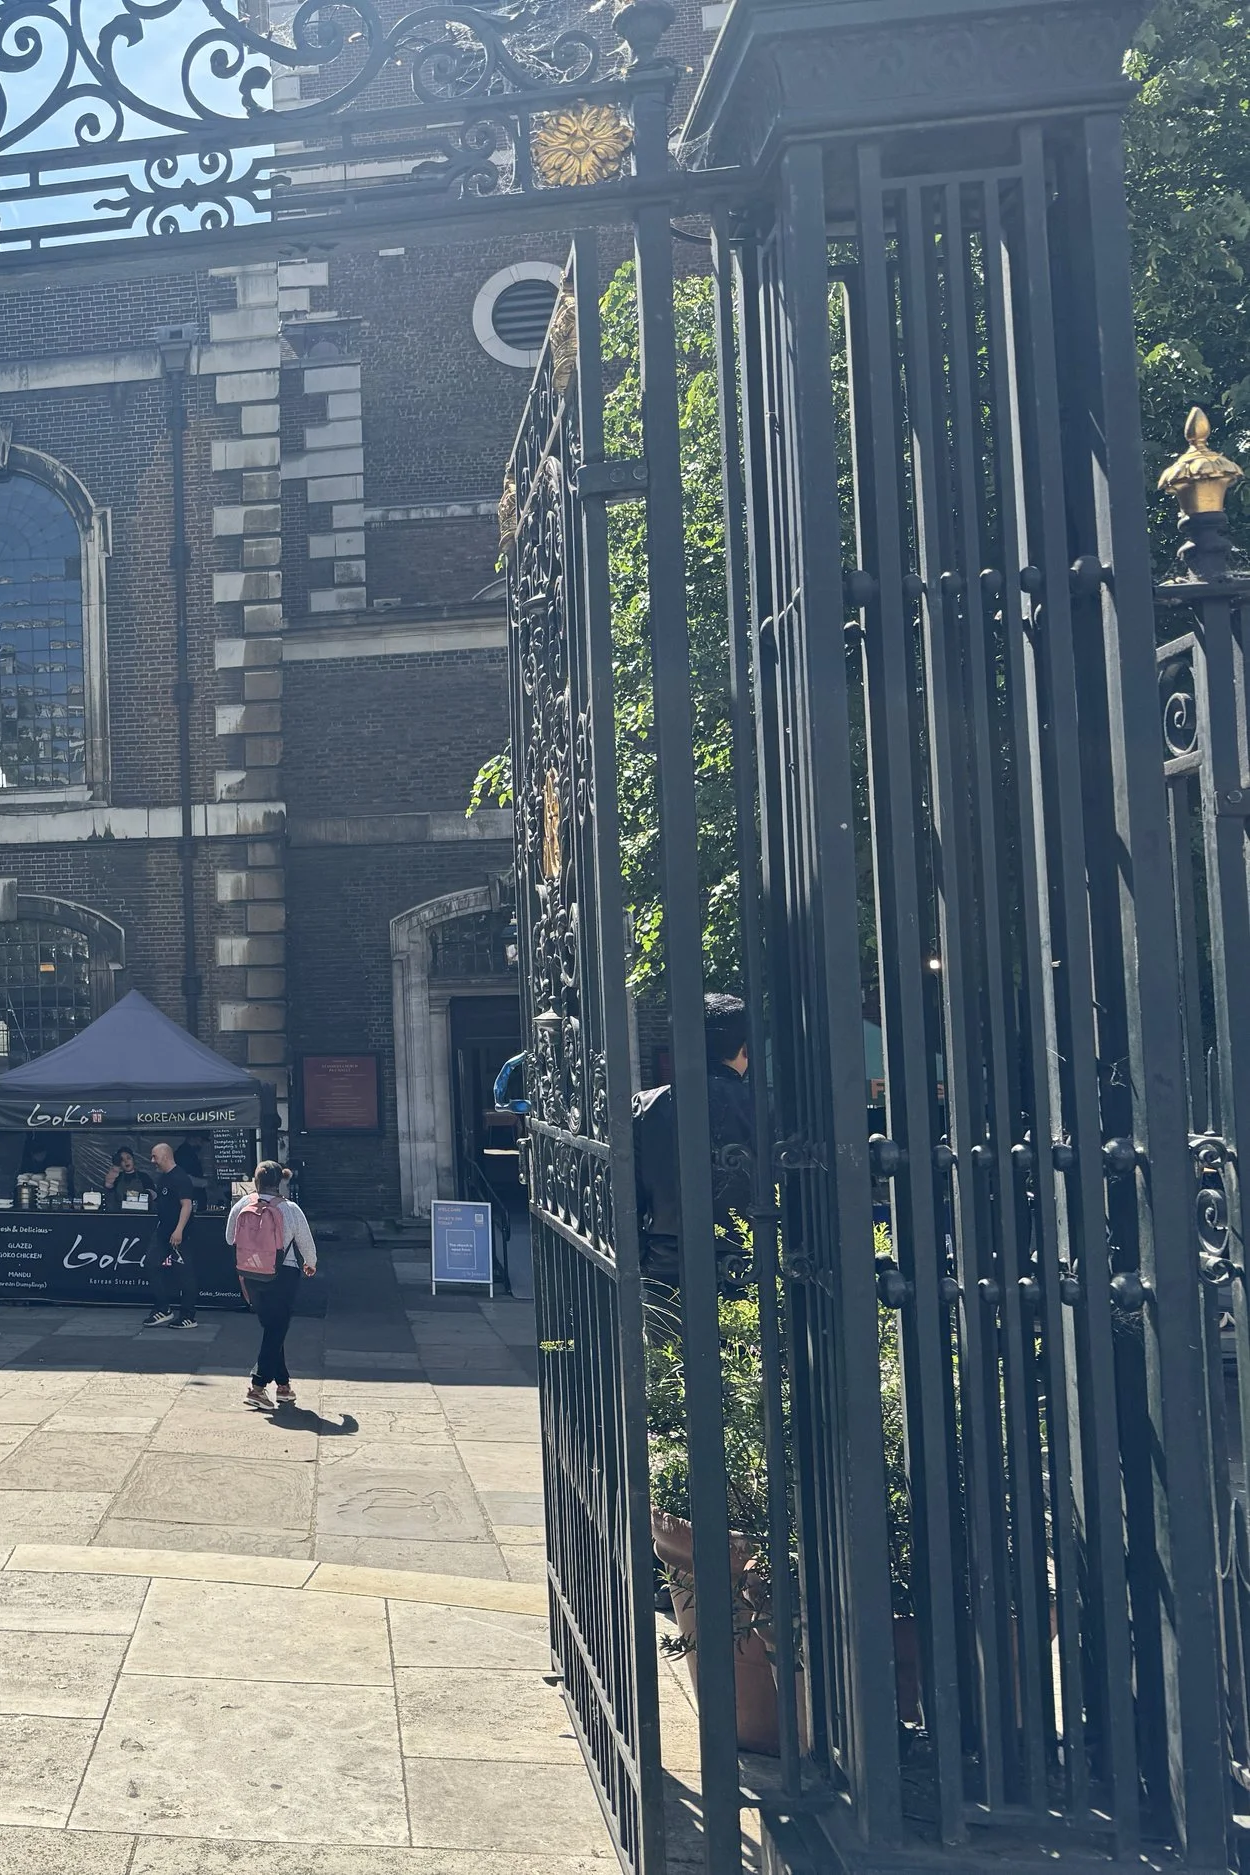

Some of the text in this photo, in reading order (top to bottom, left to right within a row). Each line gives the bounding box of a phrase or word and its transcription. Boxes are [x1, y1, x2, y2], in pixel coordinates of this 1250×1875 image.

[137, 1110, 236, 1123] KOREAN CUISINE
[12, 1225, 18, 1233] &
[16, 1281, 47, 1289] Dumplings)
[89, 1278, 112, 1286] Korean
[114, 1278, 135, 1286] Street
